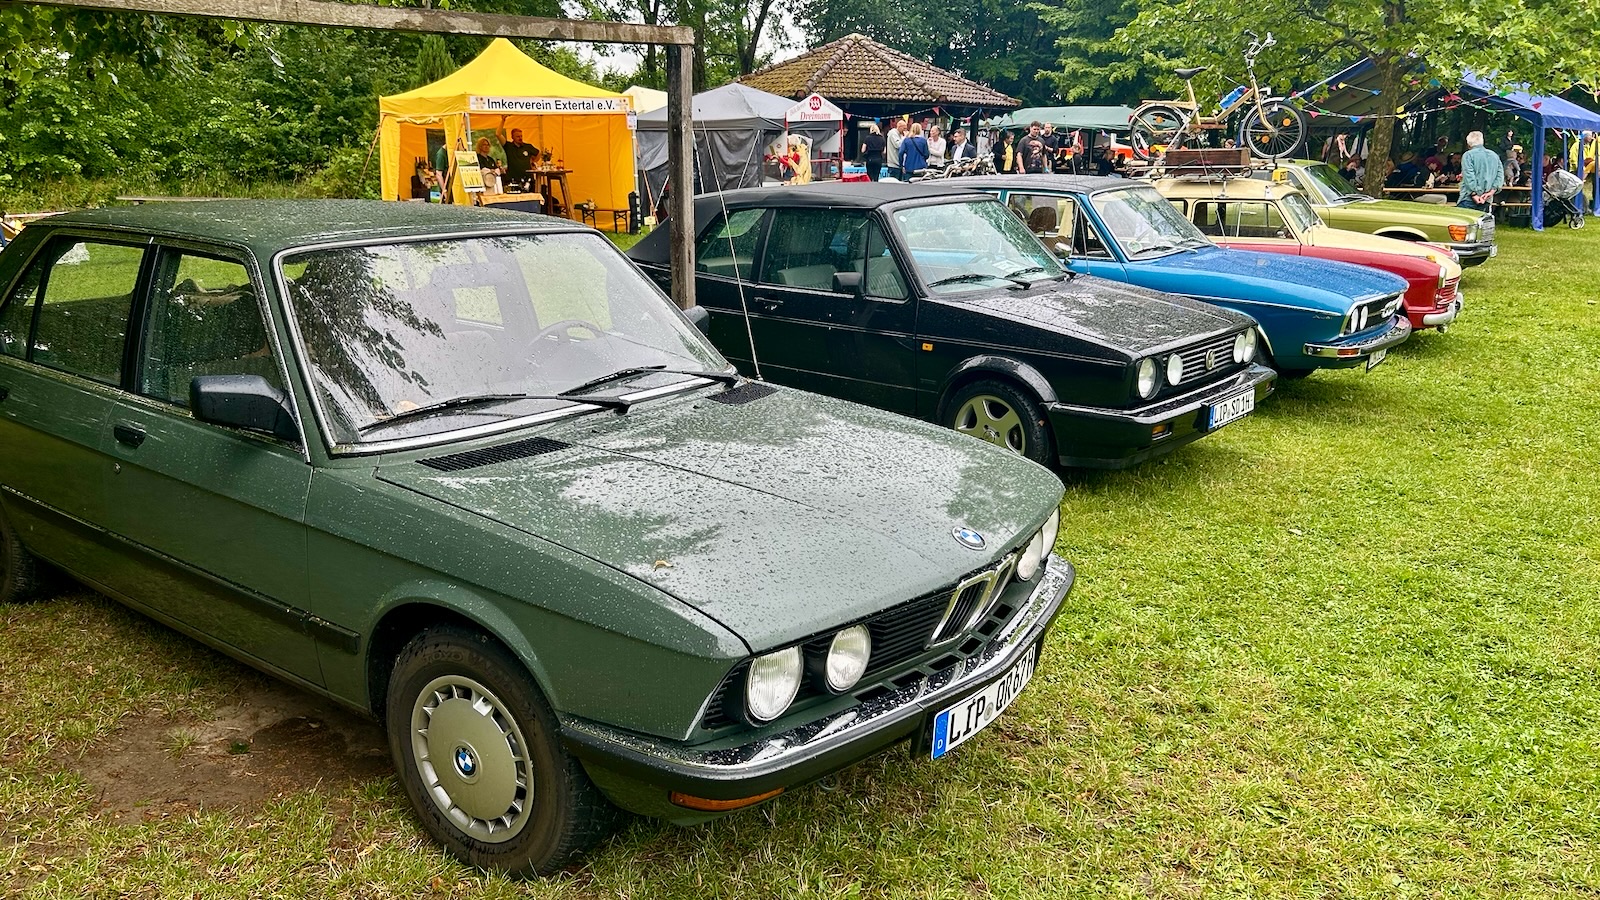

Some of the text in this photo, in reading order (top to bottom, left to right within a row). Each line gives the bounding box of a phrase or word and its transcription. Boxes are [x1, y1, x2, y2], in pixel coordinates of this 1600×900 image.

[487, 98, 615, 110] Imkerverein Extertal e.V.
[1214, 403, 1228, 424] LIP
[422, 650, 464, 664] TOYO
[949, 695, 986, 745] LIP
[937, 739, 944, 750] D
